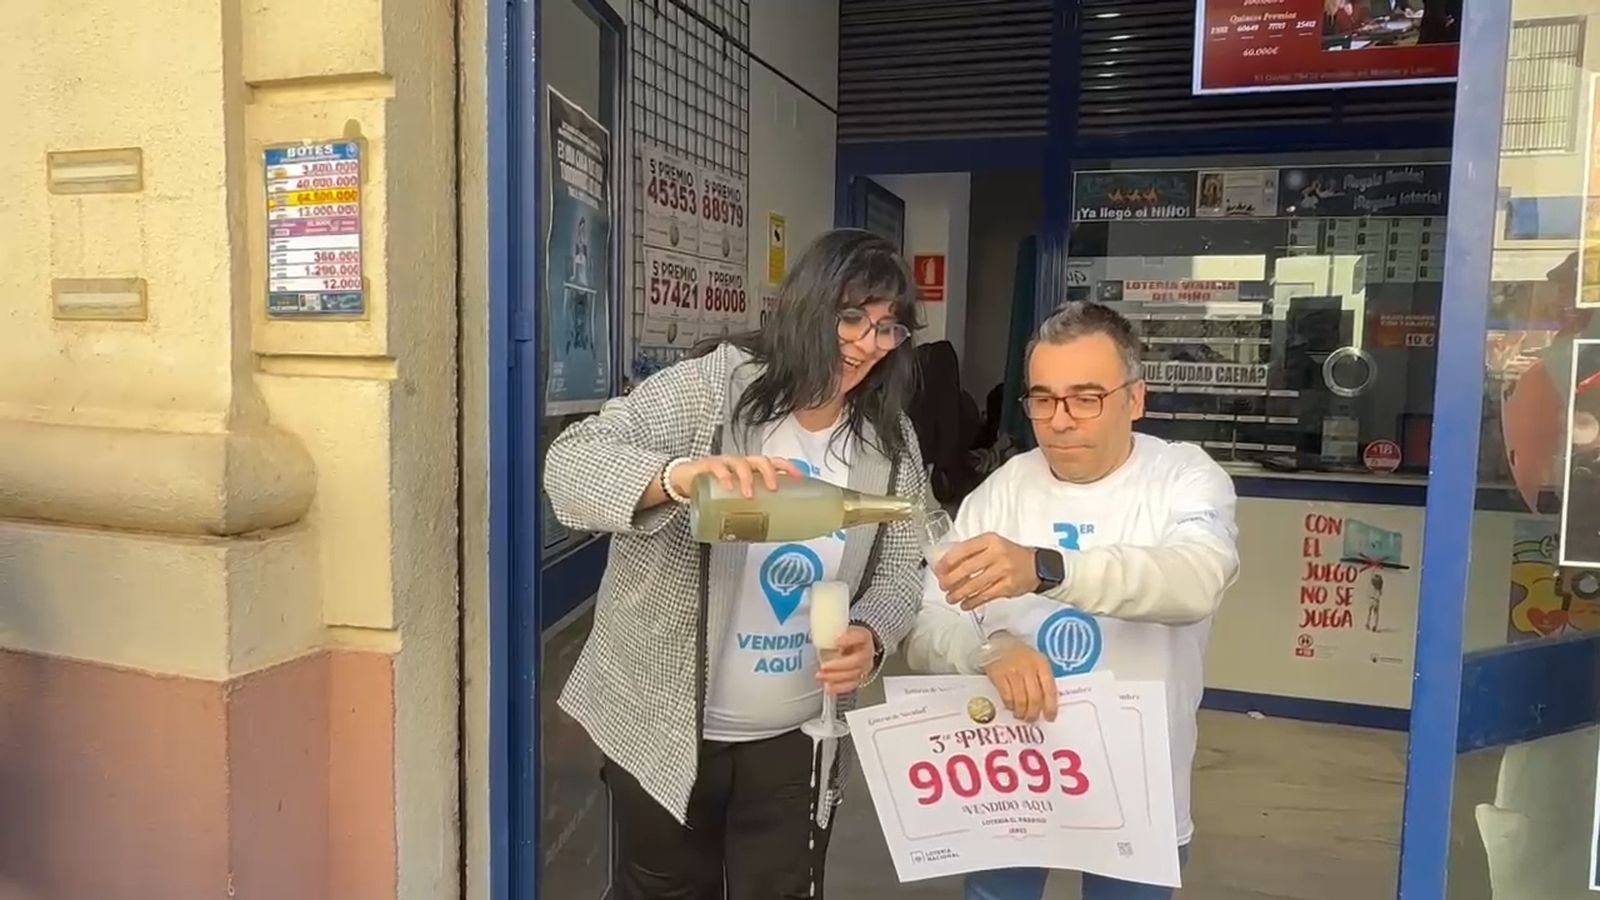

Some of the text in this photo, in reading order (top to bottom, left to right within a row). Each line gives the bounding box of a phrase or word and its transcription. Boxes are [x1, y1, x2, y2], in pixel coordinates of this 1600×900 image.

[1263, 11, 1297, 21] Premios
[1242, 46, 1280, 57] 60.000€
[286, 143, 334, 159] BOTES
[658, 161, 695, 188] PREMIO
[647, 174, 697, 216] 45353
[711, 180, 742, 203] PREMIO
[702, 194, 744, 229] 88979
[1076, 205, 1191, 220] ¡Ya llegó el NIÑO!
[661, 261, 698, 283] PREMIO
[714, 271, 743, 289] PREMIO
[323, 278, 361, 290] 12.000
[650, 277, 698, 310] 57421
[705, 285, 746, 313] 88008
[1152, 291, 1175, 302] DEL
[1408, 335, 1422, 345] 10
[1164, 364, 1213, 382] CIUDAD
[1304, 513, 1343, 536] CON
[1303, 537, 1322, 557] EL
[1301, 562, 1358, 583] JUEGO
[1300, 586, 1355, 606] NO SE
[1299, 608, 1353, 629] JUEGA
[954, 725, 1046, 749] PREMIO
[908, 748, 1091, 806] 90693
[961, 800, 1020, 815] VENDIDO
